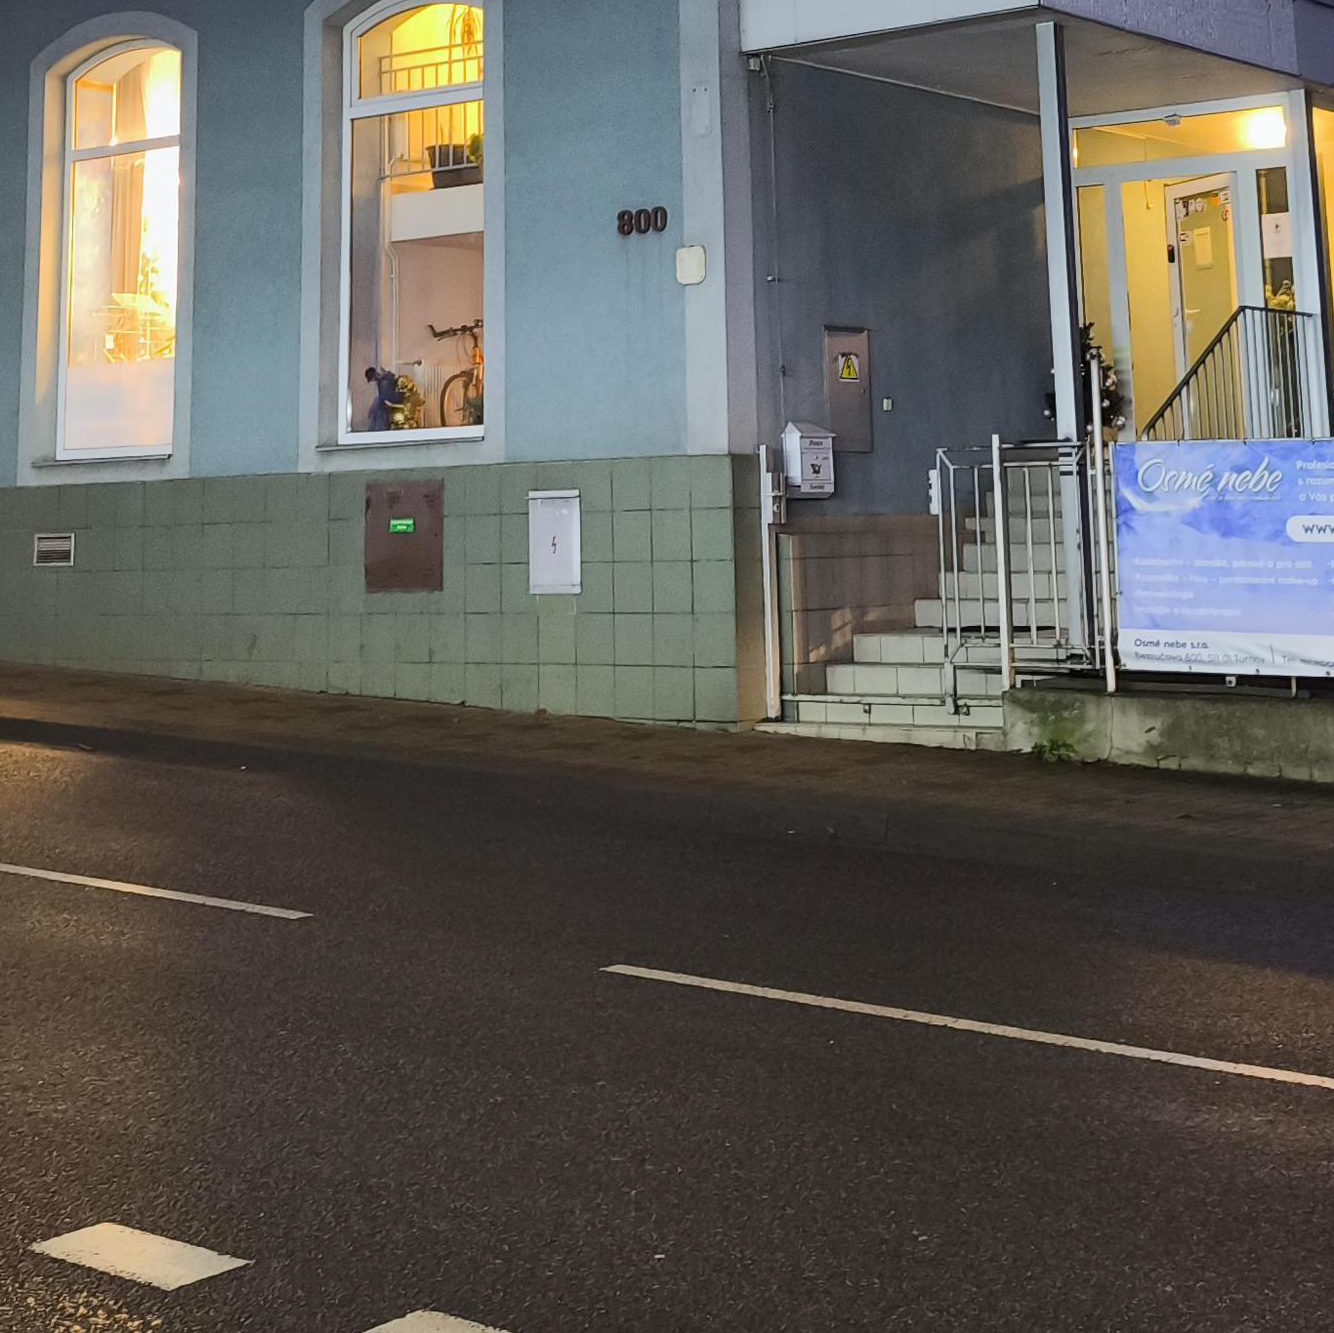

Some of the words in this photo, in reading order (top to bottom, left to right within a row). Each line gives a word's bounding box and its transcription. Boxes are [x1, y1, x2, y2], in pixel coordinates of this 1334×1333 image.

[617, 206, 668, 236] 800
[1137, 457, 1216, 497] Osmé
[1217, 455, 1283, 493] nebe
[1164, 639, 1187, 649] nebe
